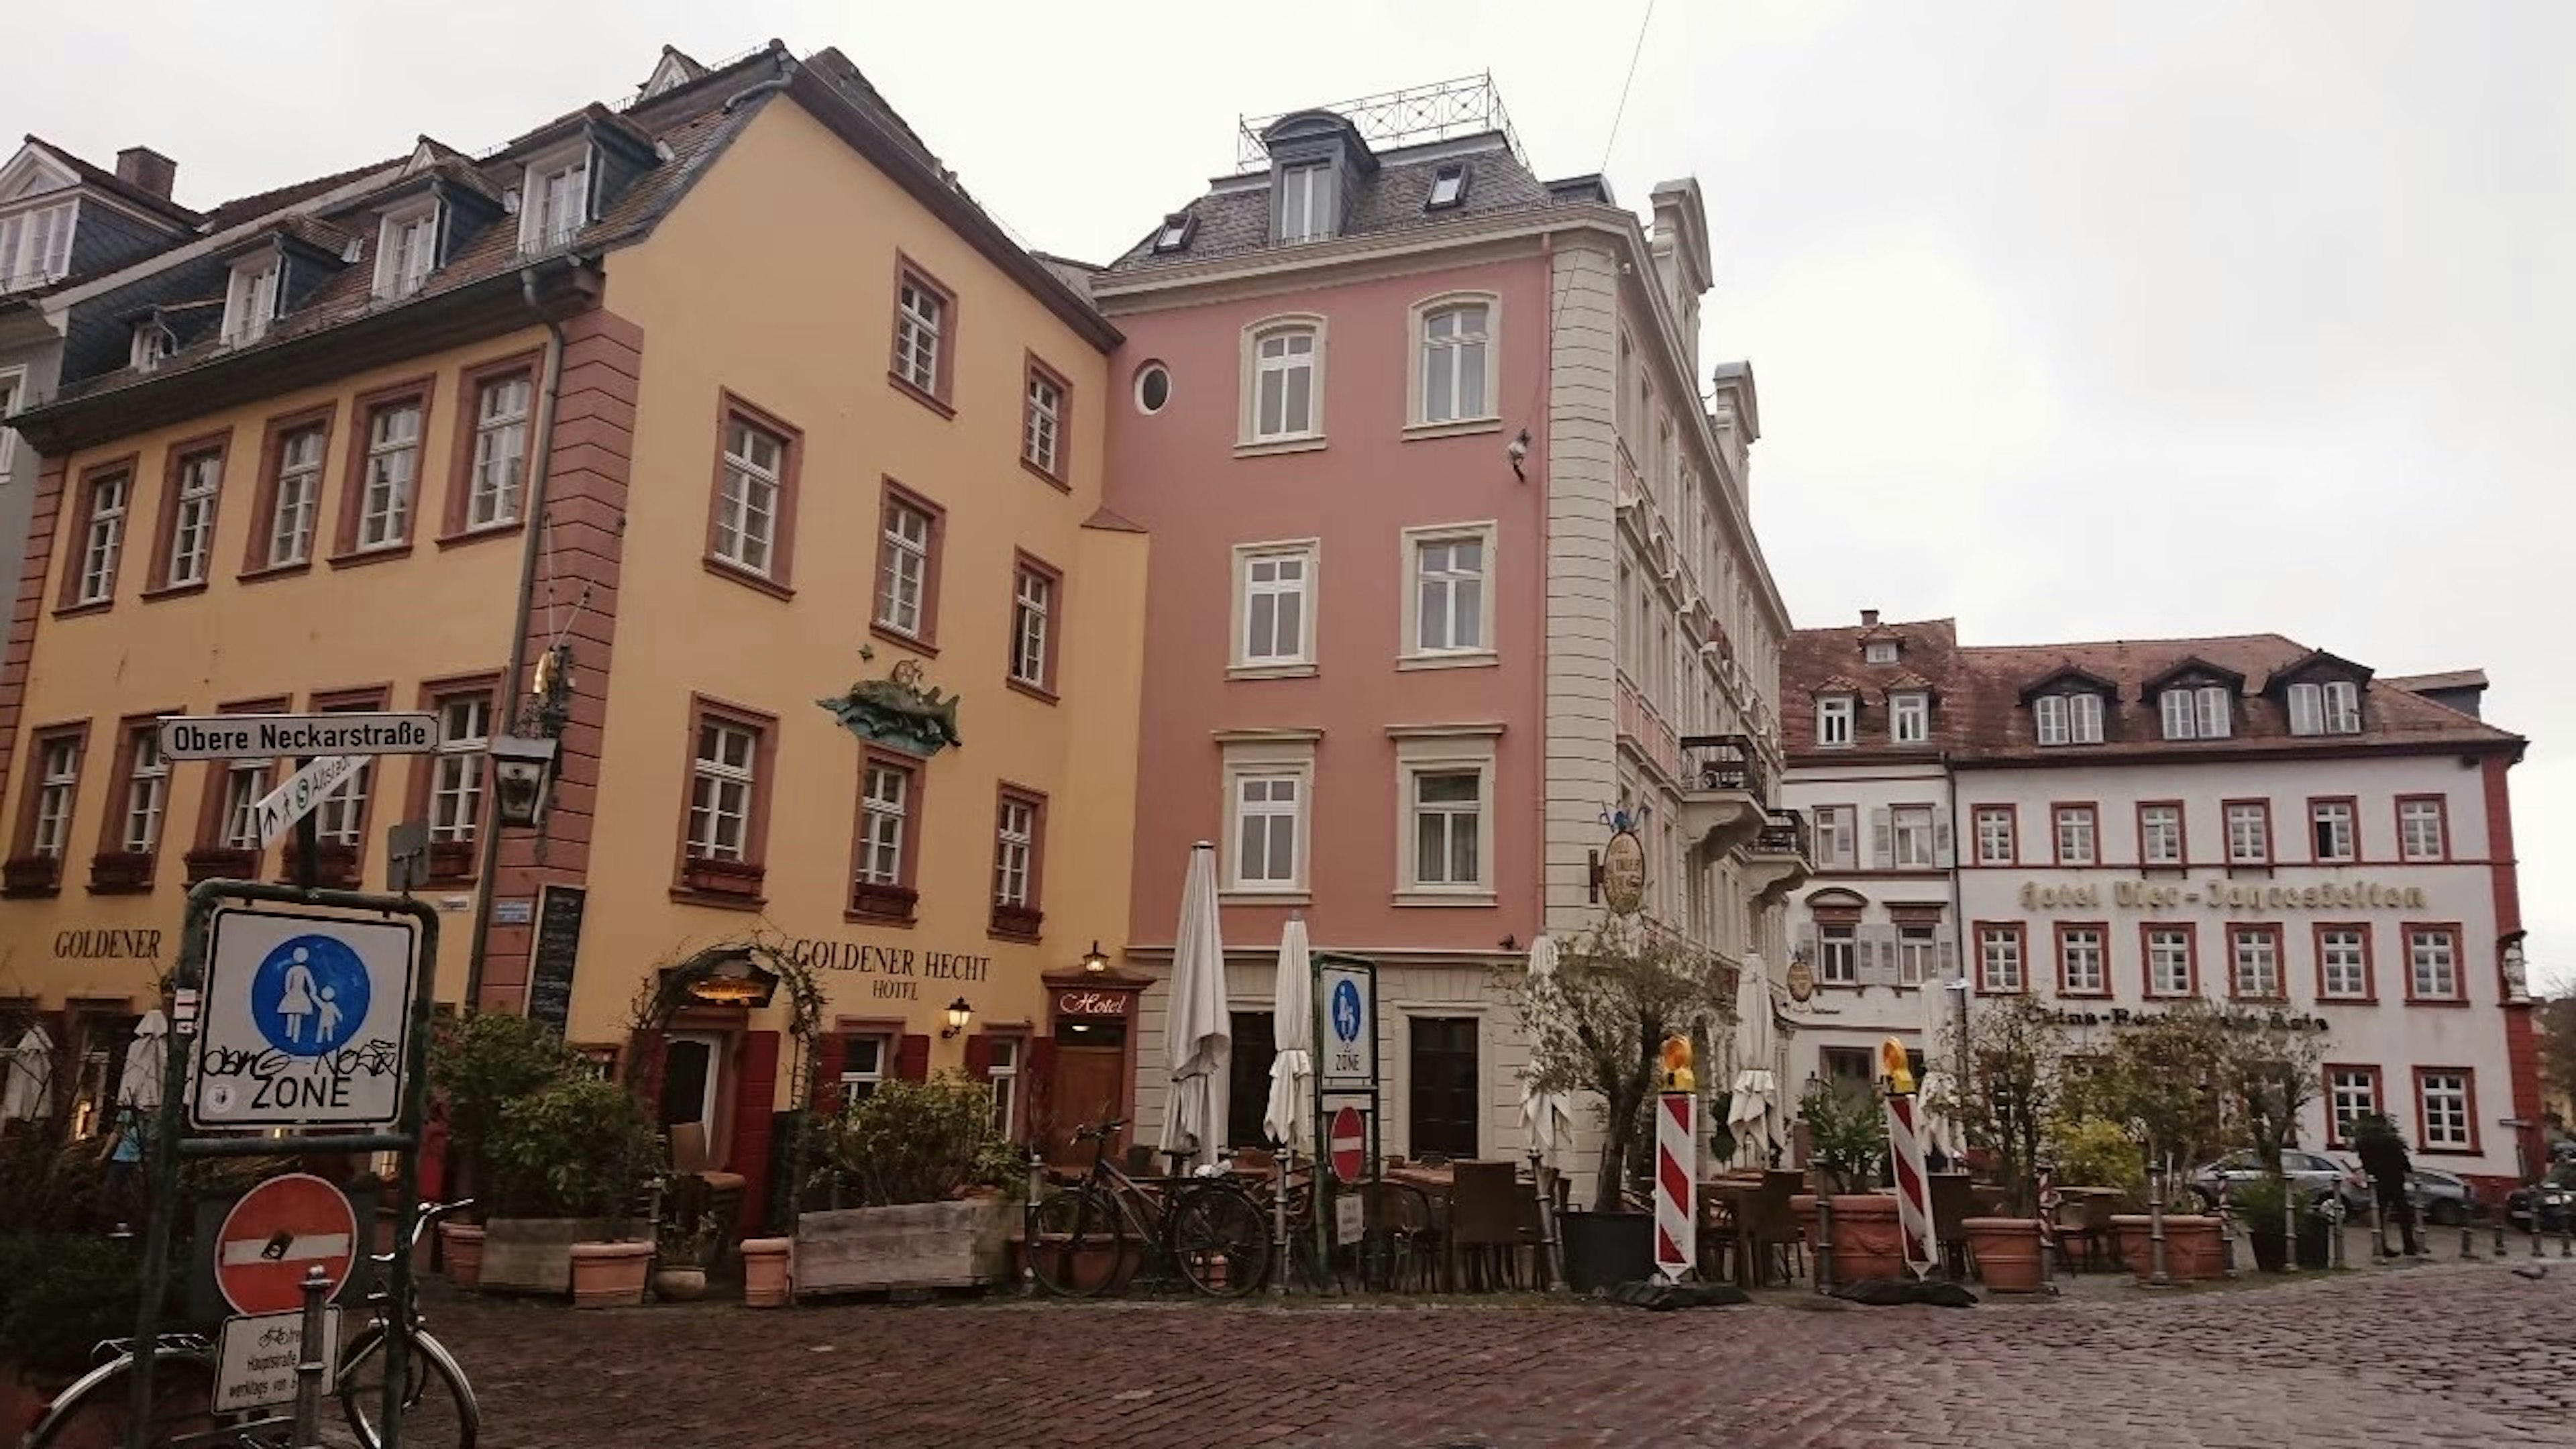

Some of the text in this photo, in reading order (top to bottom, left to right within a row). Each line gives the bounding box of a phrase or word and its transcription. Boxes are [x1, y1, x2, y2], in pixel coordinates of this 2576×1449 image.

[174, 722, 426, 751] Obere Neckarstraße
[55, 929, 162, 959] GOLDENER
[793, 939, 991, 982] GOLDENER HECHT
[872, 979, 919, 1001] HOTEL
[1059, 992, 1127, 1015] Hotel
[1336, 1053, 1360, 1071] ZONE
[252, 1075, 352, 1109] ZONE
